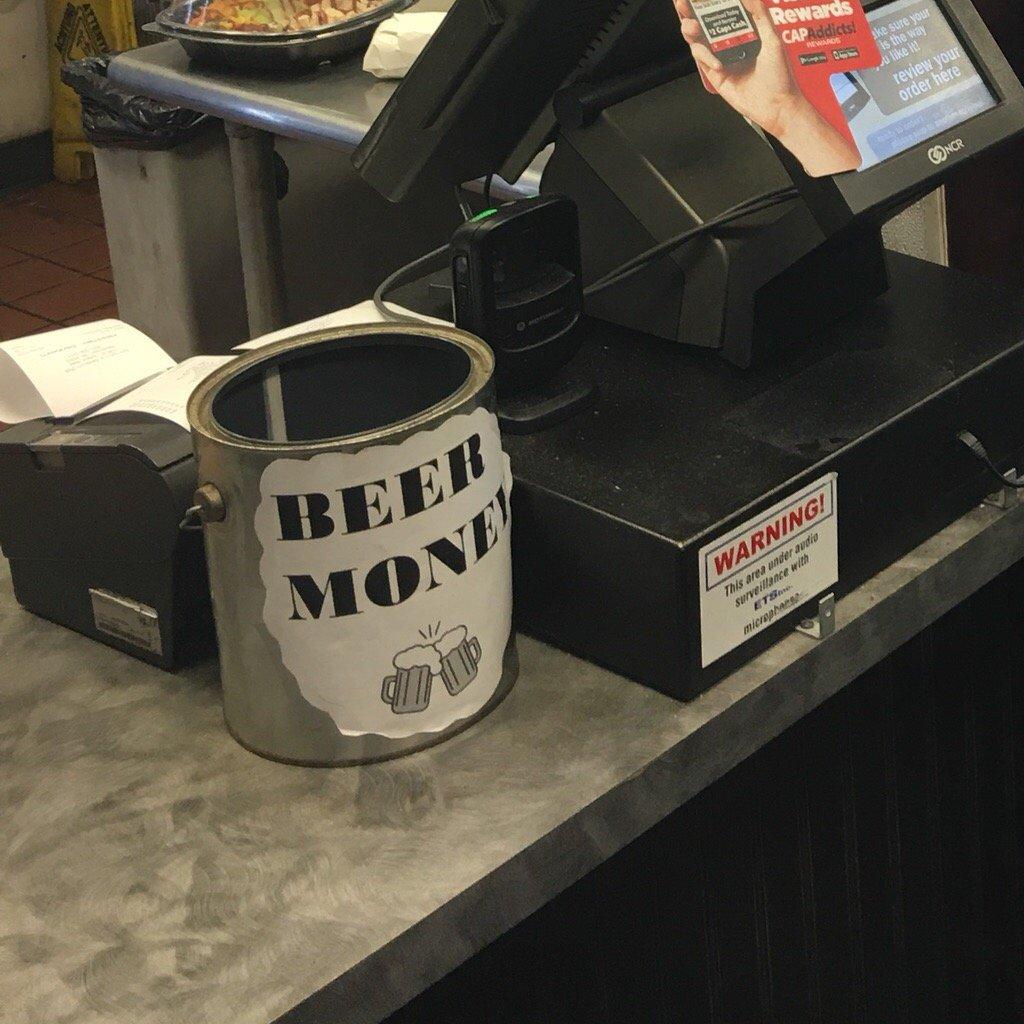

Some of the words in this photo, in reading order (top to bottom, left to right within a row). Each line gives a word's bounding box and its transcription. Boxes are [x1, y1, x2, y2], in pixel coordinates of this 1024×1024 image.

[782, 22, 857, 45] CAPAddicts!
[890, 16, 910, 33] sure
[910, 7, 931, 27] your
[806, 37, 842, 48] REWARDS
[881, 40, 890, 51] is
[891, 33, 908, 47] the
[908, 25, 928, 42] way
[891, 45, 908, 62] like
[908, 40, 919, 53] it!
[892, 59, 934, 85] review
[934, 46, 961, 70] your
[899, 79, 933, 102] order
[933, 65, 962, 86] here
[945, 138, 965, 155] NCR
[270, 433, 486, 542] BEER
[713, 492, 825, 576] WARNING!
[724, 579, 745, 598] This
[746, 564, 766, 583] area
[768, 549, 793, 574] under
[795, 531, 819, 554] audio
[734, 570, 790, 608] surveillance
[791, 554, 810, 573] with
